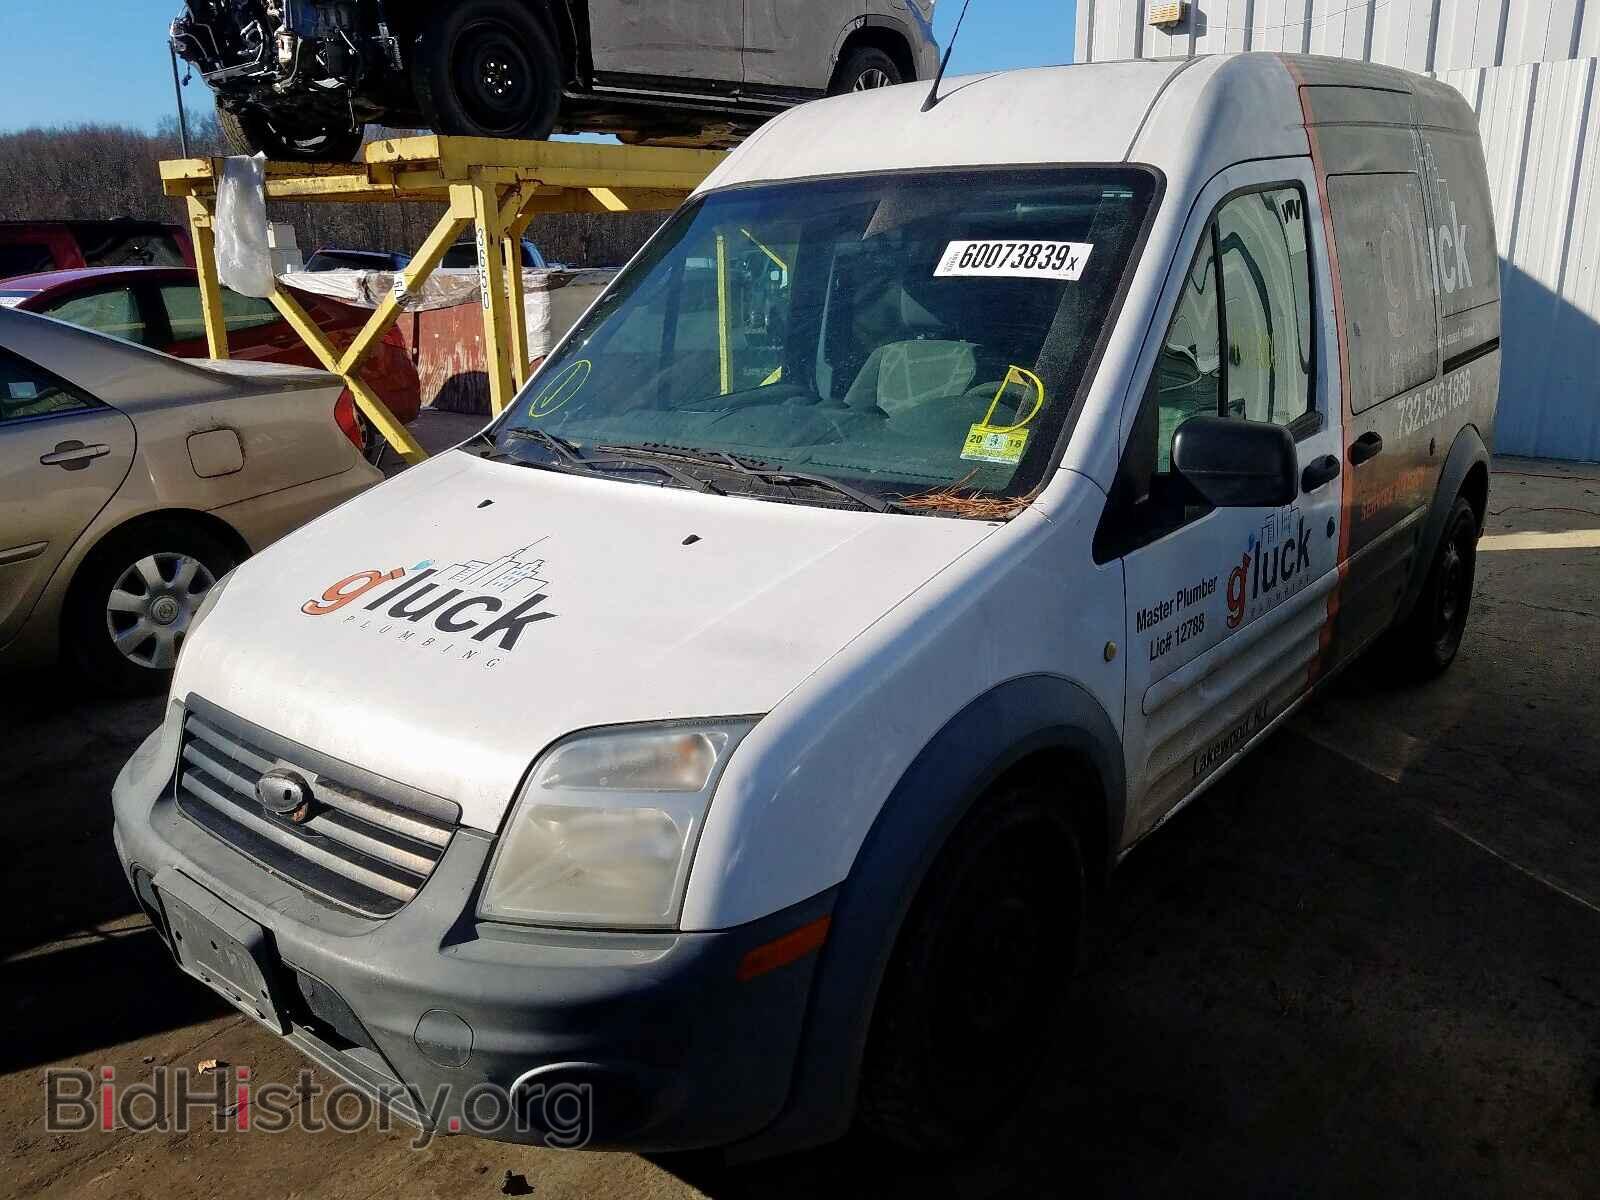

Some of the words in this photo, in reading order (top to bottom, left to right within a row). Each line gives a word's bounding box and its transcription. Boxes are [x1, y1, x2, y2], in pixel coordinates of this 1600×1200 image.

[477, 228, 490, 310] 3650
[1136, 598, 1175, 634] Master
[1176, 575, 1218, 608] Plumber
[343, 614, 502, 669] PLUMBING
[1149, 631, 1173, 664] Lic#
[1175, 613, 1205, 647] 12788
